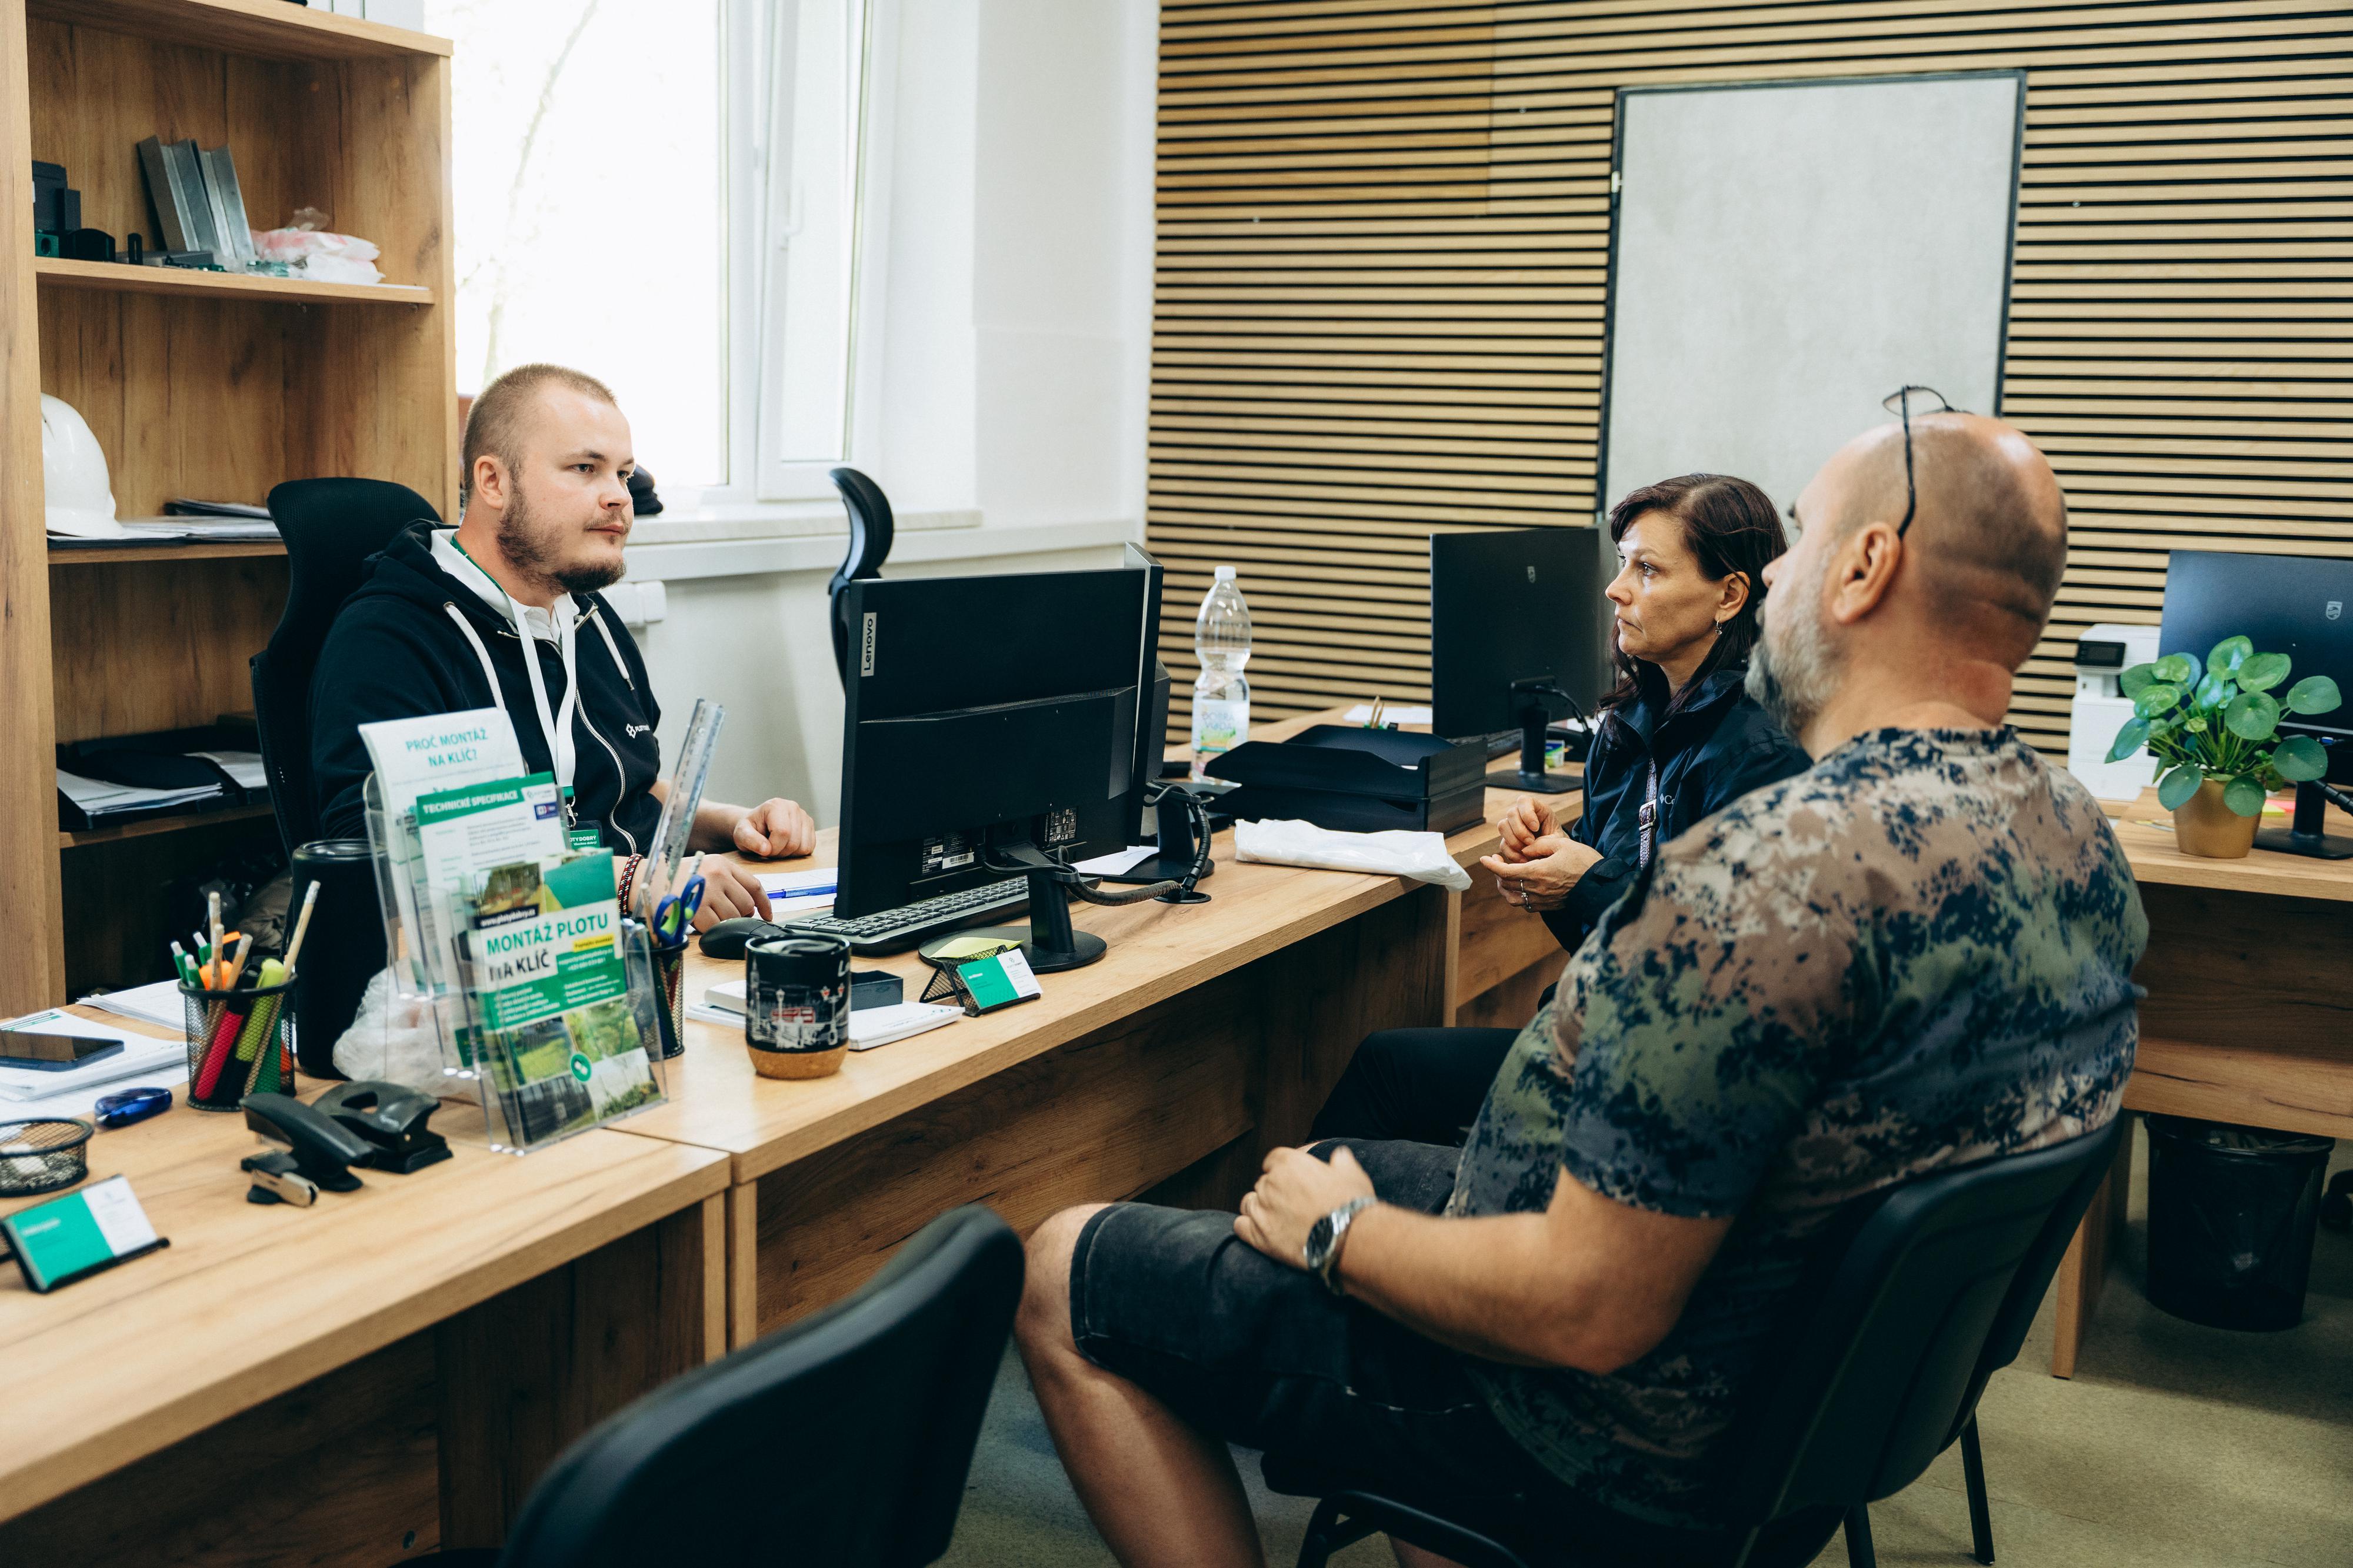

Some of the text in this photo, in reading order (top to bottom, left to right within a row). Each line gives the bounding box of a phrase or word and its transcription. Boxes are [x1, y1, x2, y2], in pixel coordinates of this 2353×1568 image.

[864, 618, 873, 670] Lenovo
[406, 727, 489, 752] PROČ MONTÁŽ
[428, 748, 478, 767] NA KLÍČ?
[423, 796, 471, 814] TECHNICKÉ
[471, 789, 518, 807] SPECIFIKACE
[480, 908, 536, 927] www.plotydobry.cz
[487, 912, 608, 956] MONTÁŽ PLOTU
[516, 948, 550, 973] KLÍČ
